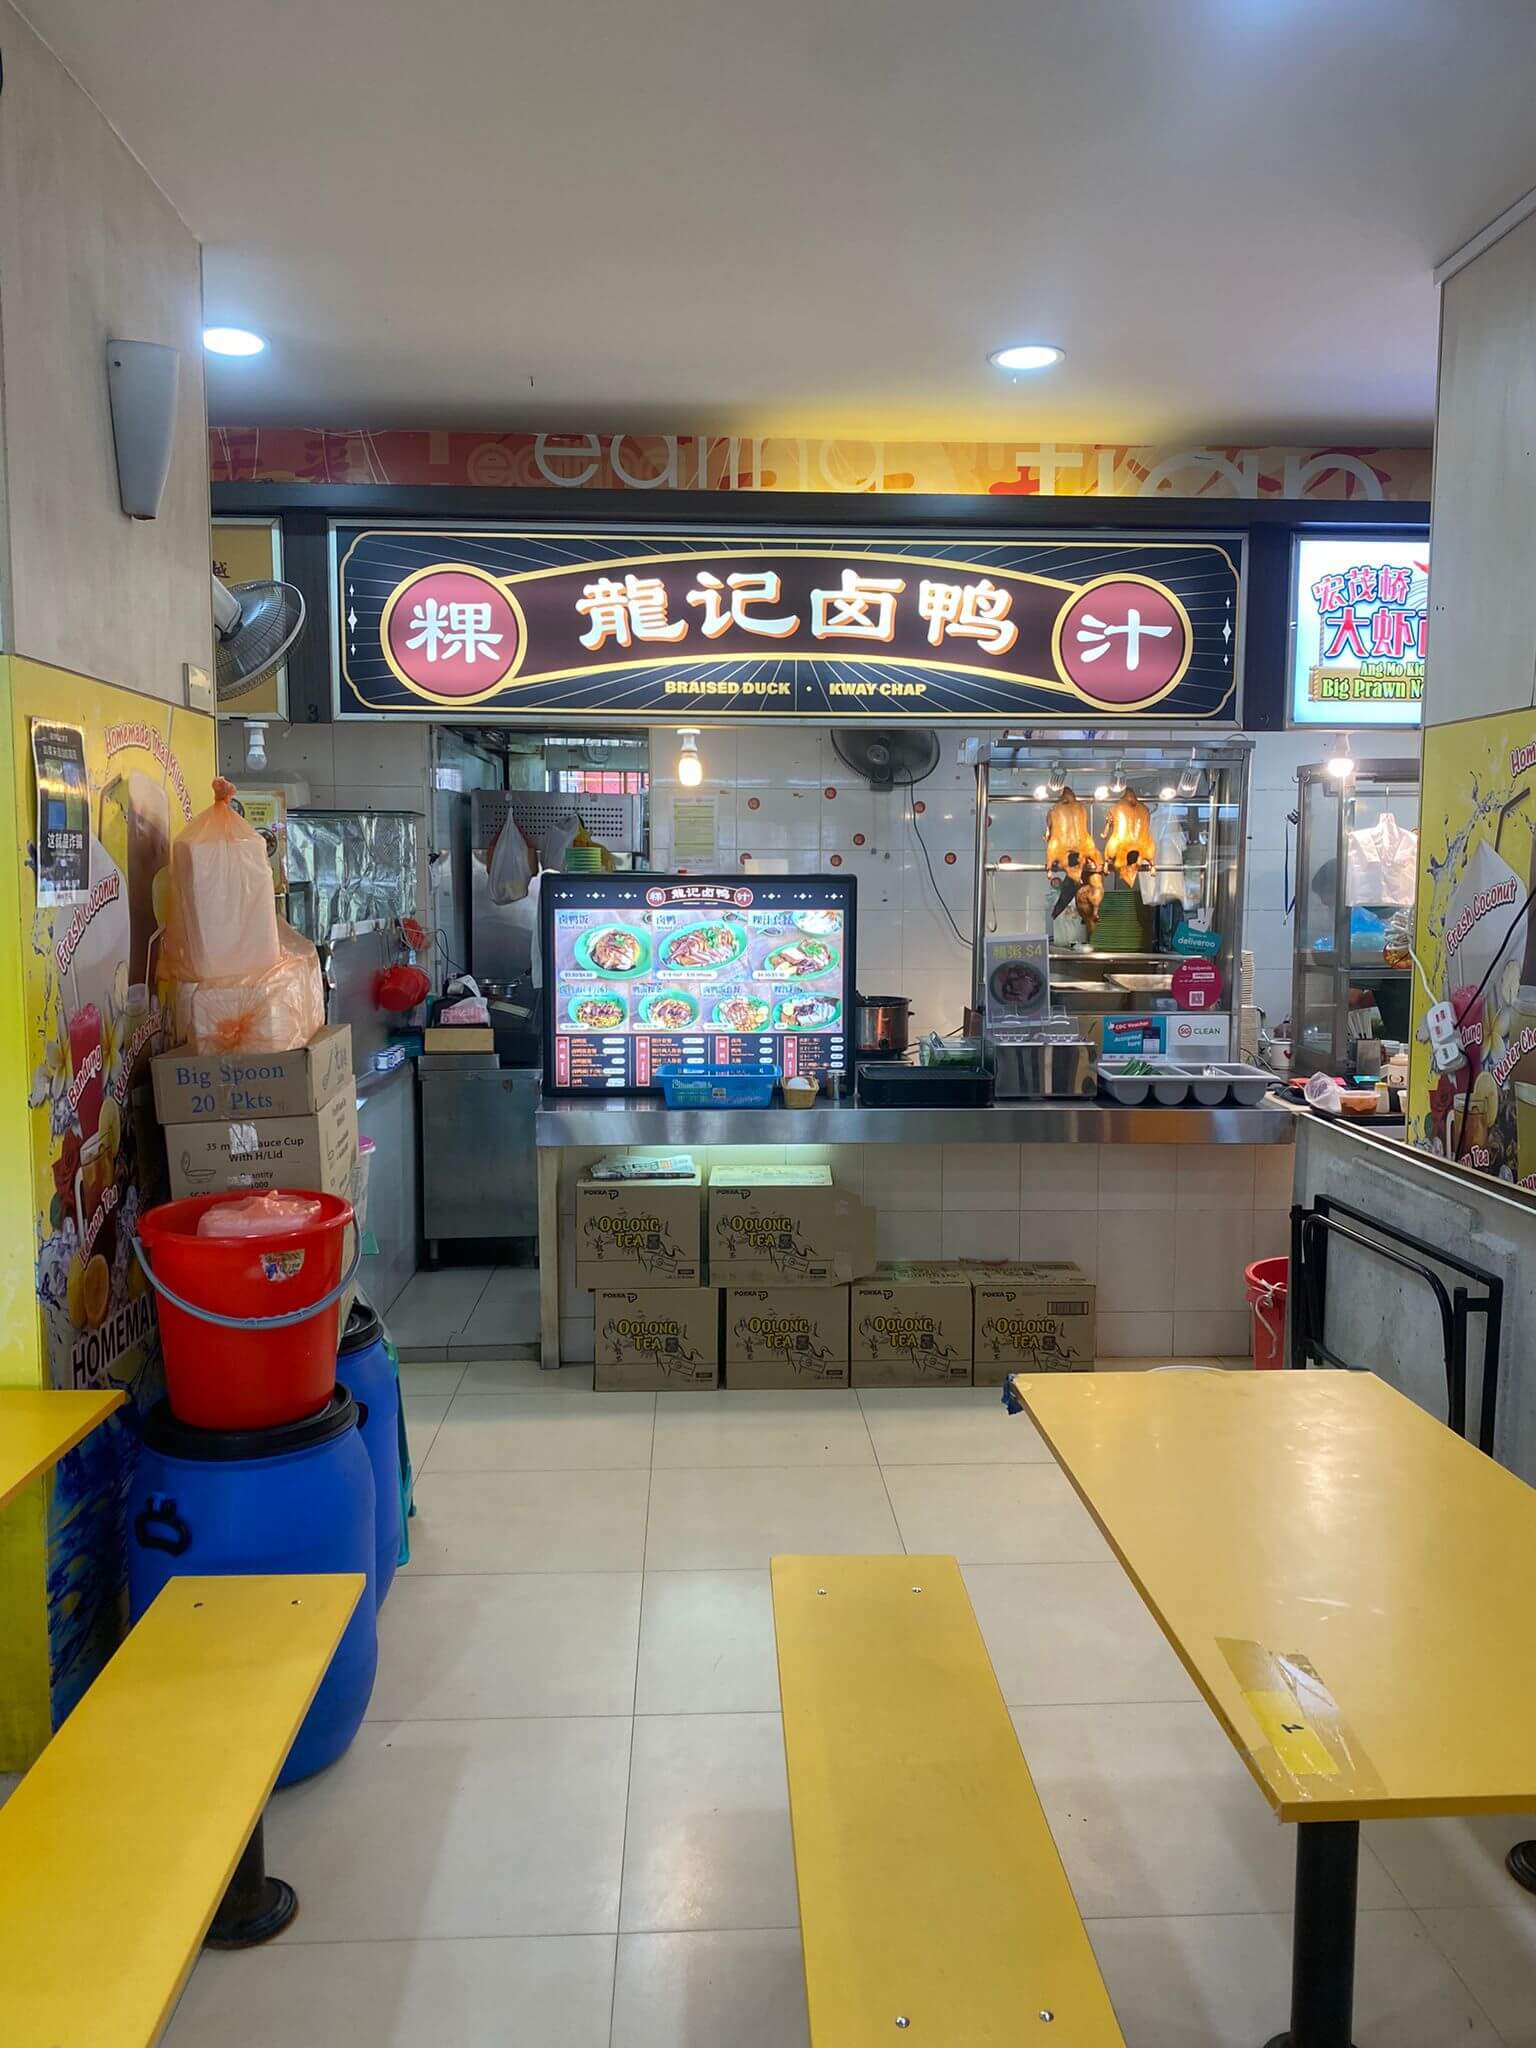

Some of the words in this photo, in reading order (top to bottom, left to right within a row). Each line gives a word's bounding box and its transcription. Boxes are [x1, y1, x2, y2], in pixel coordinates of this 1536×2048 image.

[1311, 565, 1413, 614] 宏茂桥
[576, 568, 1018, 655] 龍记卤鸭
[405, 597, 504, 664] 粿
[1076, 608, 1173, 671] 汁
[1360, 661, 1385, 679] Ang
[1386, 662, 1404, 678] Mo
[664, 681, 740, 695] BRAISED
[743, 681, 791, 695] DUCK
[828, 682, 877, 696] KWAY
[880, 682, 928, 697] CHAP
[1321, 677, 1350, 700] Big
[1352, 678, 1406, 699] Prawn
[55, 907, 84, 976] Fresh
[83, 871, 120, 923] Coconut
[1446, 905, 1475, 957] Fresh
[1473, 876, 1517, 921] Coconut
[1178, 936, 1216, 949] deliveroo
[1193, 1027, 1221, 1035] CLEAN
[1492, 1041, 1521, 1088] Water
[67, 1044, 102, 1110] Bandung
[176, 1067, 211, 1088] Big
[220, 1064, 285, 1086] Spoon
[191, 1096, 215, 1113] 20
[231, 1093, 273, 1111] Pkts
[206, 1143, 217, 1151] 35
[257, 1138, 281, 1148] auce
[283, 1136, 304, 1149] Cup
[228, 1152, 253, 1163] With
[1471, 1144, 1490, 1168] Tea
[101, 1184, 119, 1215] Tea
[598, 1216, 661, 1233] OOLONG
[730, 1216, 793, 1233] OOLONG
[614, 1233, 645, 1248] TEA
[747, 1233, 777, 1248] TEA
[617, 1319, 679, 1336] OOLONG
[748, 1317, 810, 1333] OOLONG
[873, 1316, 936, 1333] OOLONG
[996, 1317, 1057, 1334] OOLONG
[633, 1335, 663, 1352] TEA
[764, 1333, 793, 1349] TEA
[888, 1332, 918, 1349] TEA
[1010, 1333, 1040, 1350] TEA
